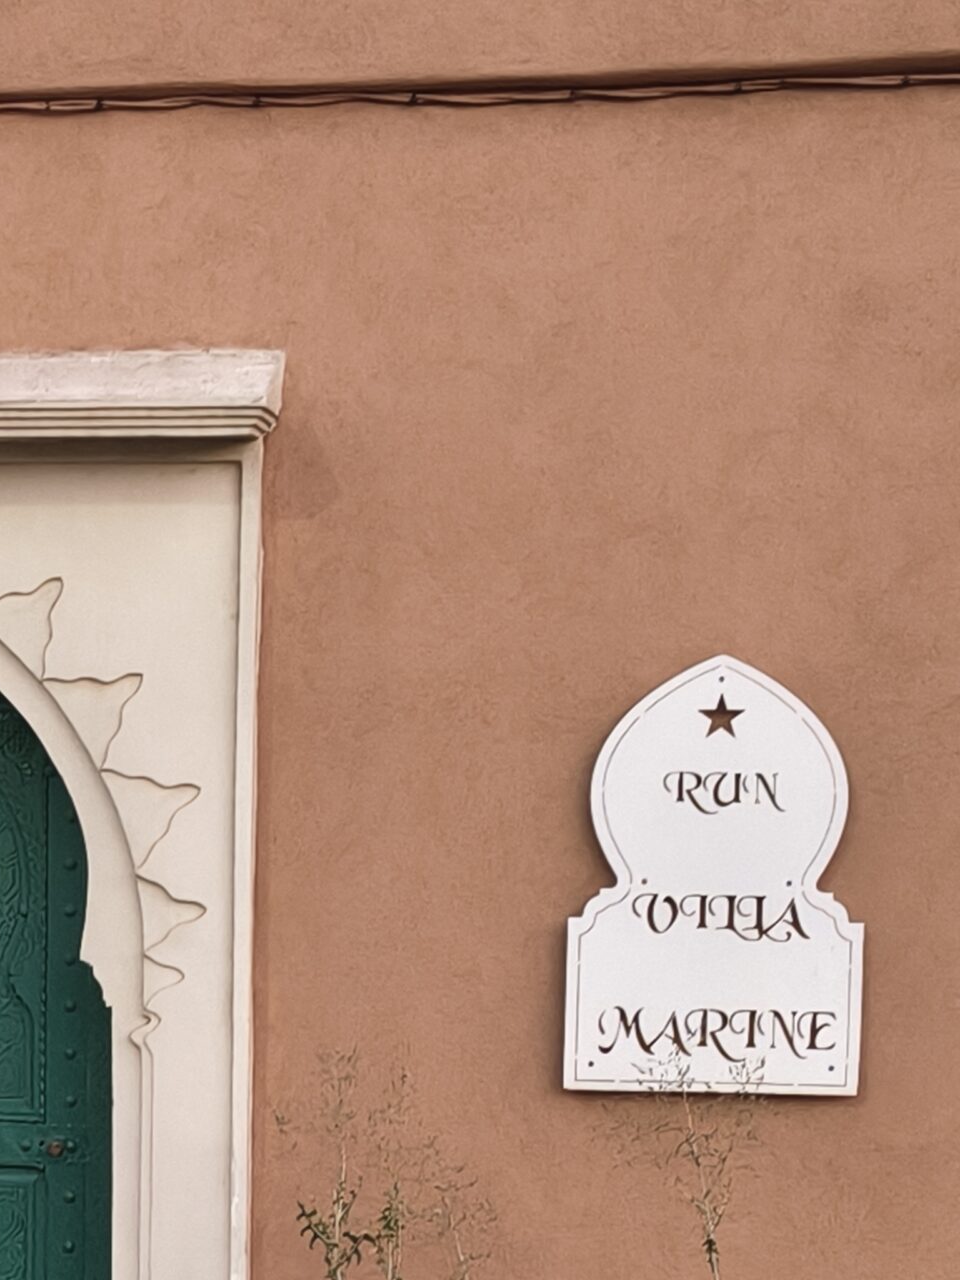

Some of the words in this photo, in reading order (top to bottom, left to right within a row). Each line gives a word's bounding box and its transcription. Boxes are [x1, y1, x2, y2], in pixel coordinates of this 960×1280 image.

[662, 771, 786, 815] RUN
[631, 892, 811, 943] VILLA
[597, 1005, 837, 1063] MARINE
